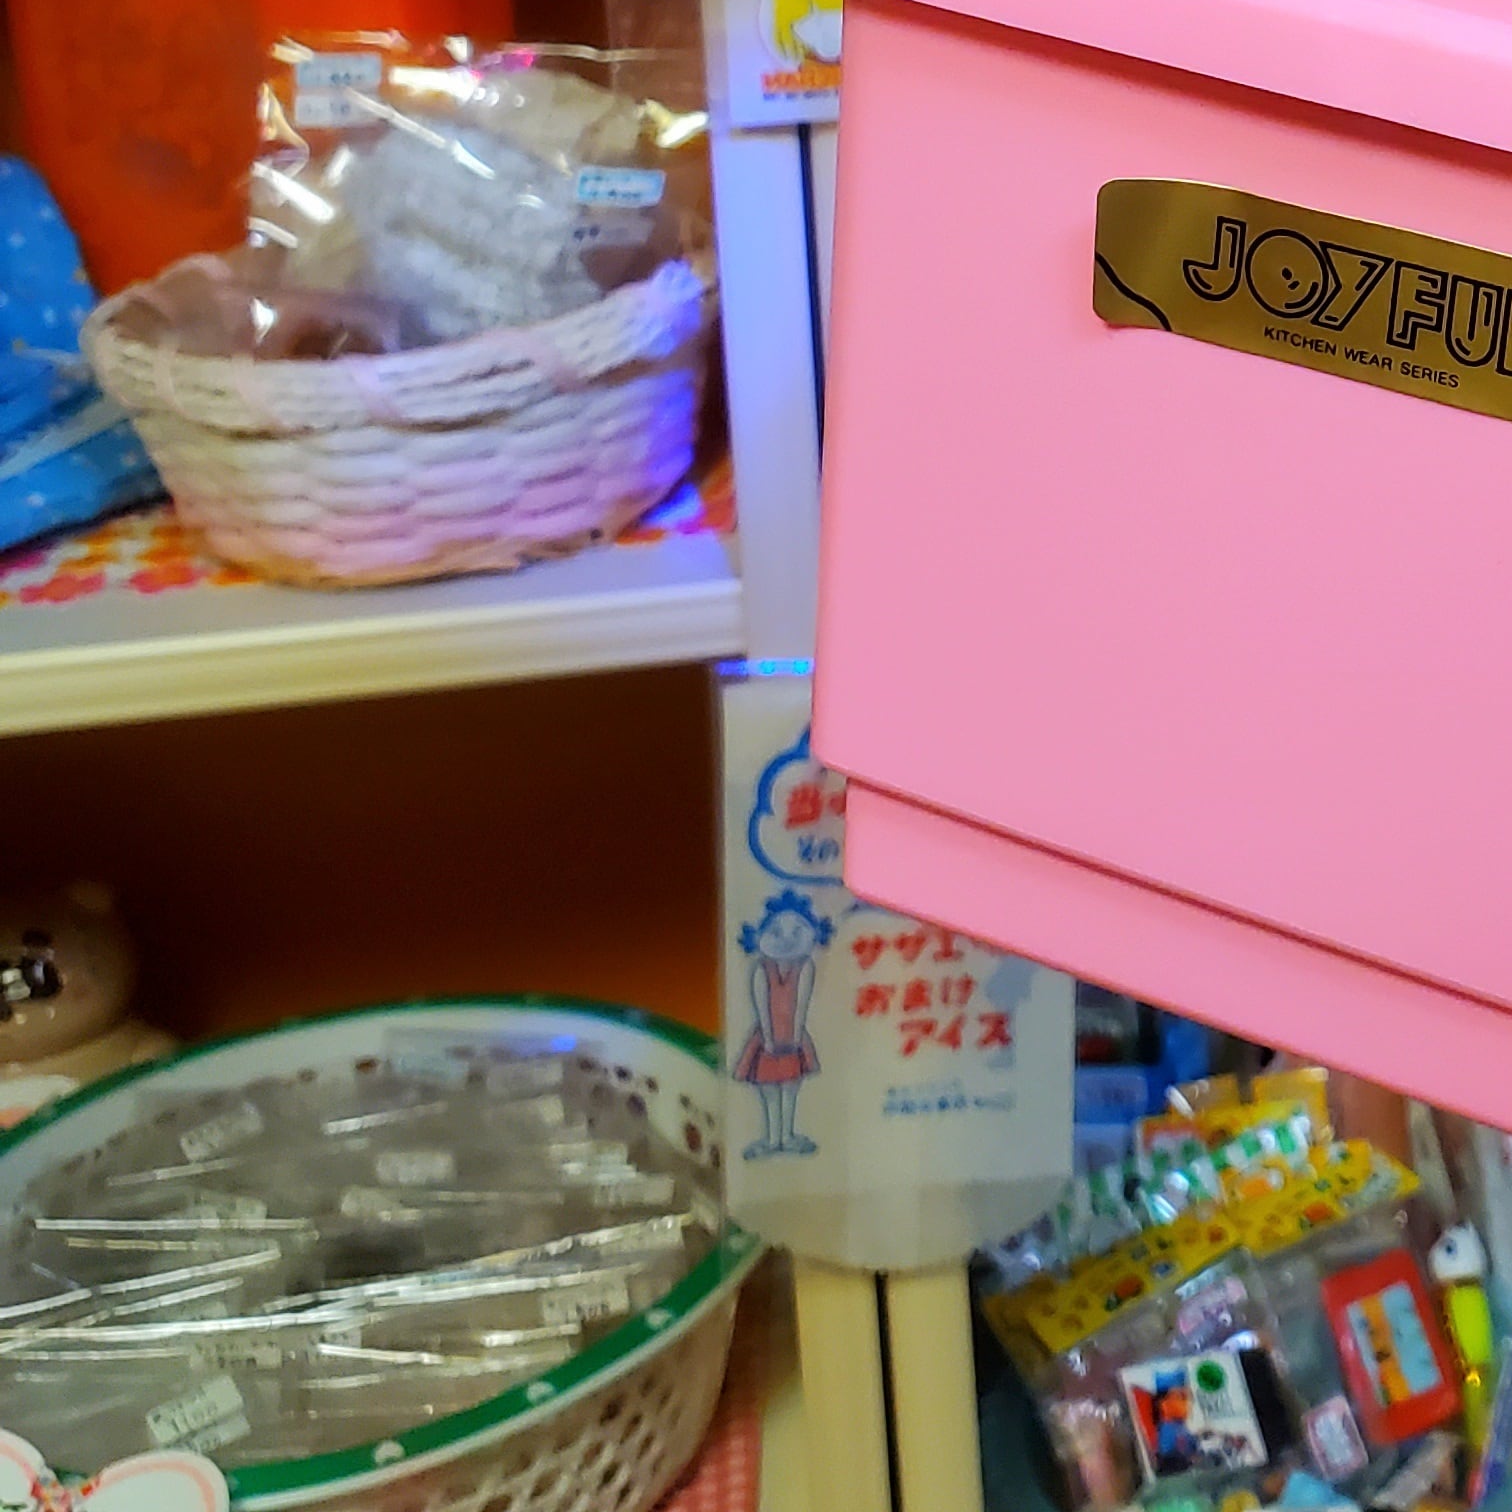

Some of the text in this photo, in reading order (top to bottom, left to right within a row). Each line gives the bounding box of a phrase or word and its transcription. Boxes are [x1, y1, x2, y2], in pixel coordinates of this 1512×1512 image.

[1263, 325, 1460, 389] KITCHEN WEAR SERIES
[898, 1010, 1014, 1057] アイス
